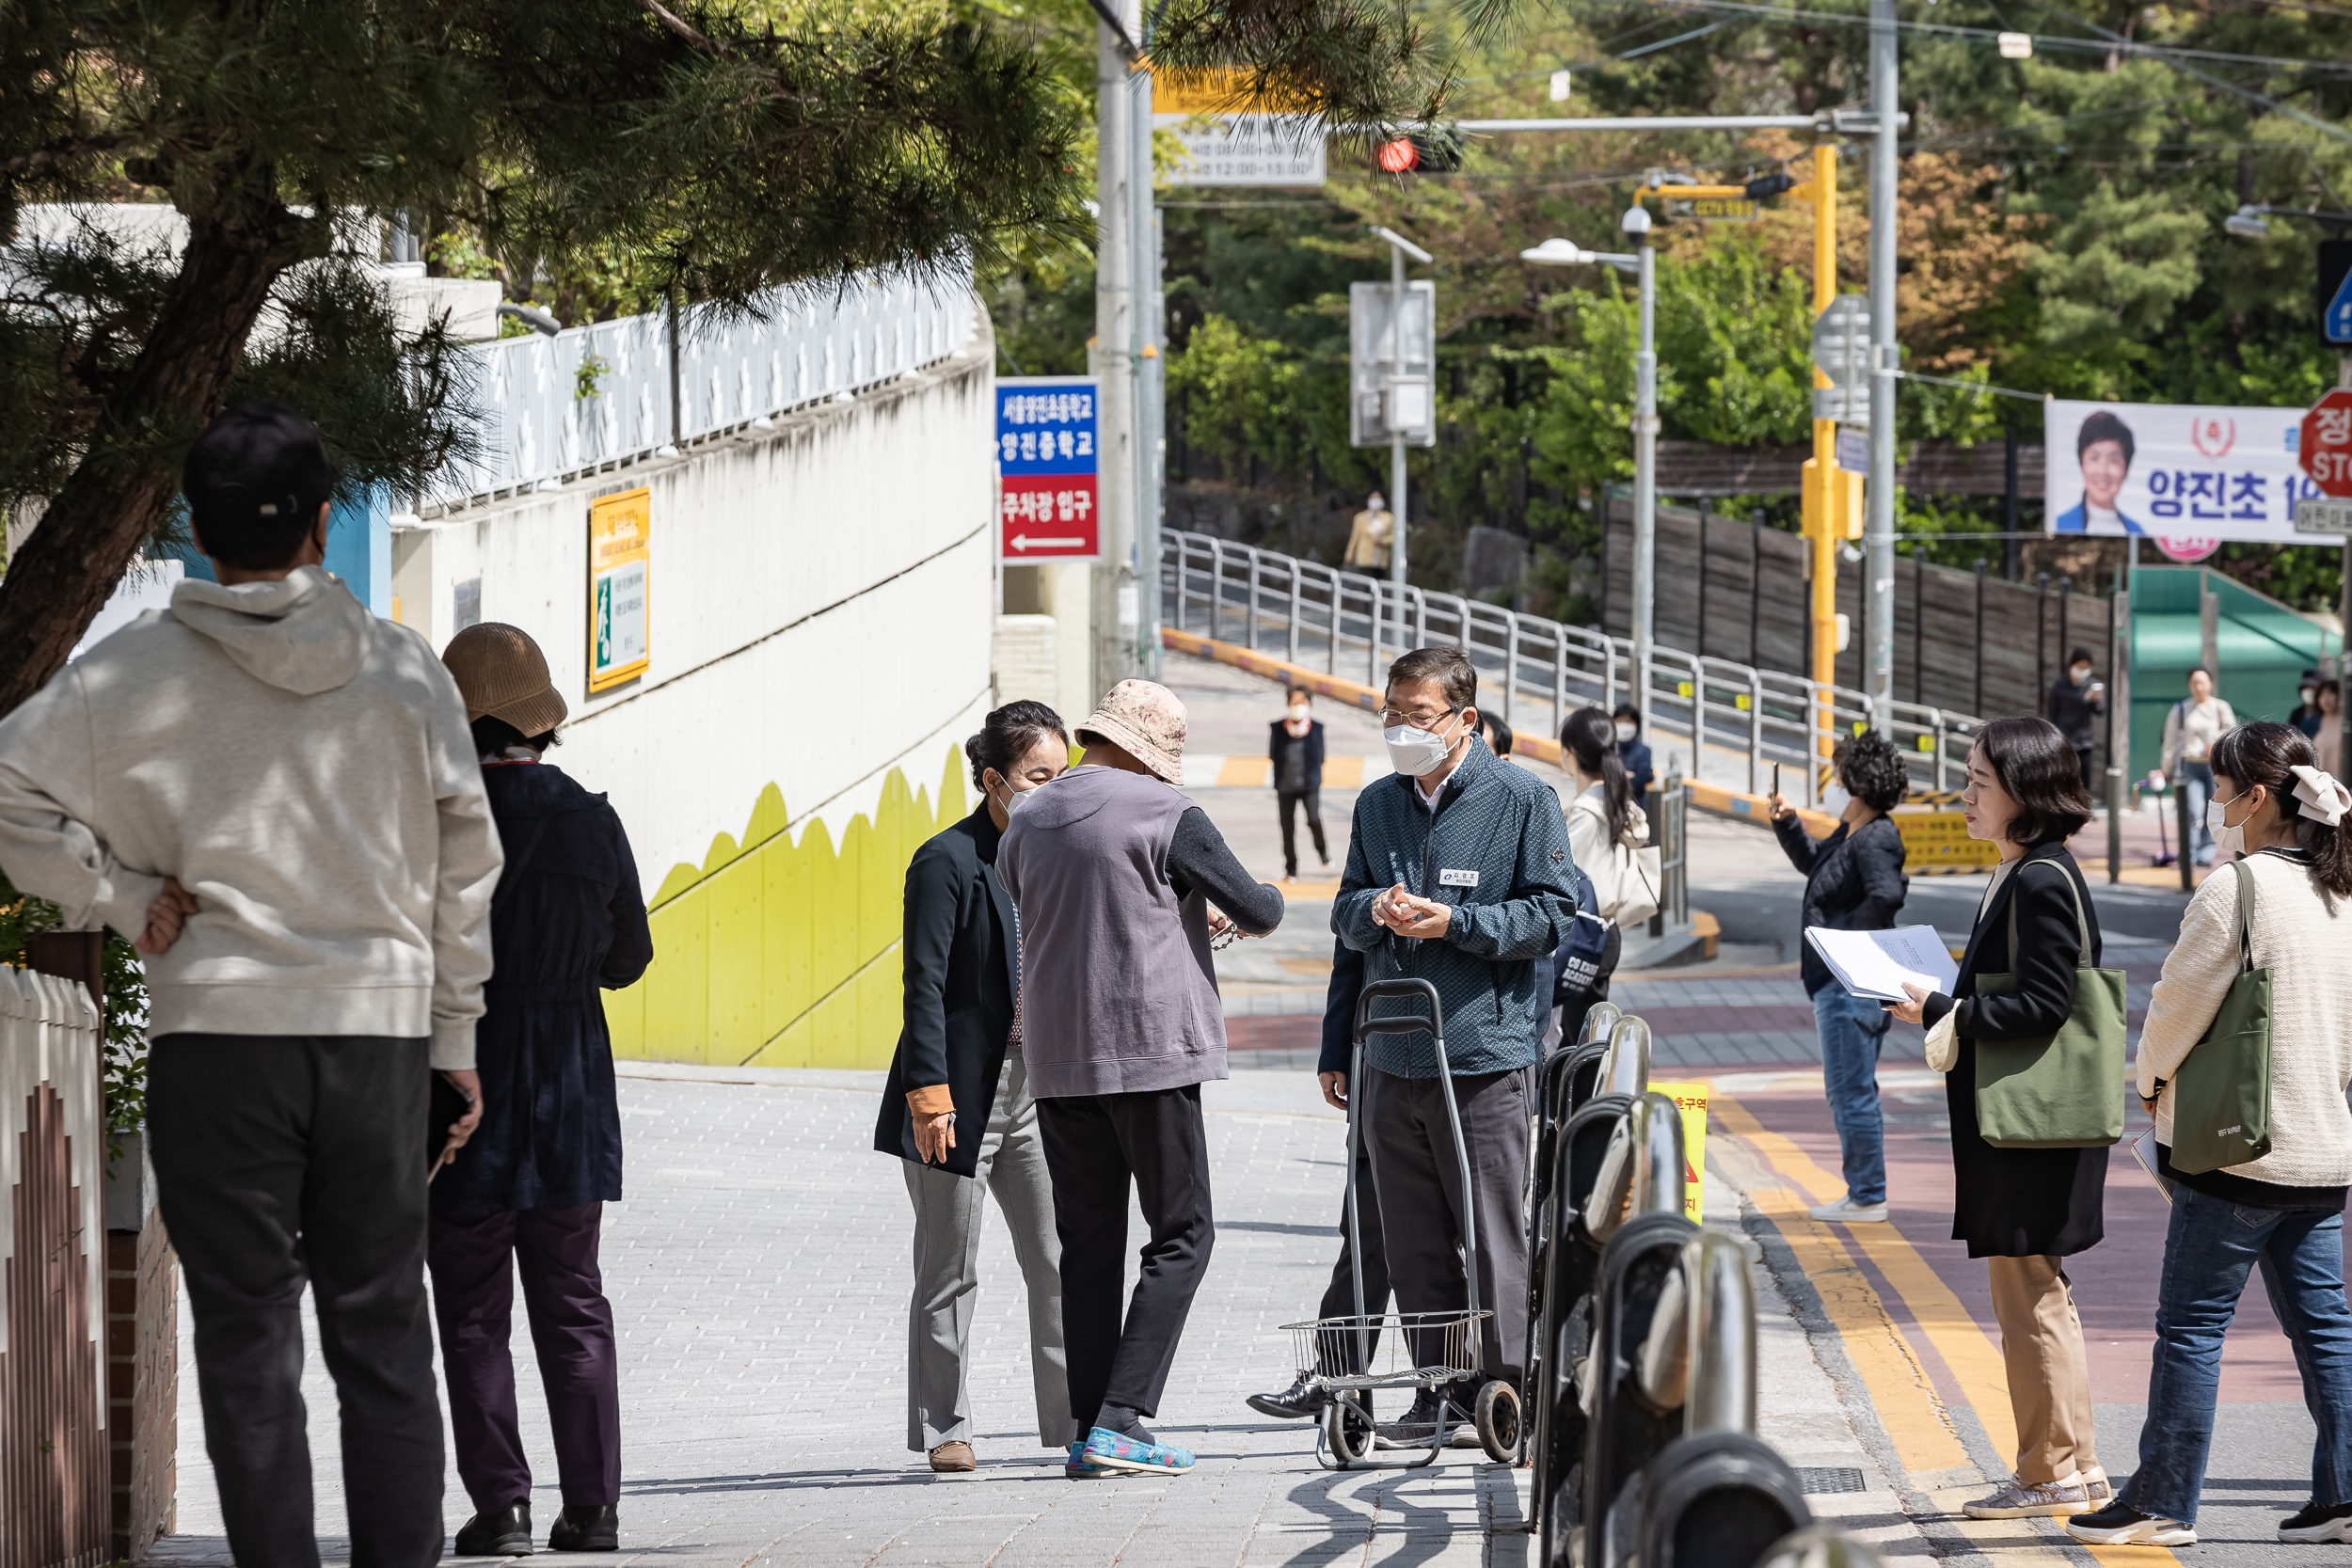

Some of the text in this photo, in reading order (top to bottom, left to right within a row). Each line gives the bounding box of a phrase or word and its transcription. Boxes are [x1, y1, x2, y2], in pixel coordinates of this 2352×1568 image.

[1003, 393, 1093, 424] 서울양진초등학교
[1001, 430, 1093, 462] 양진중학교
[1003, 489, 1092, 523] 주차장 입구
[2149, 469, 2267, 520] 양진초
